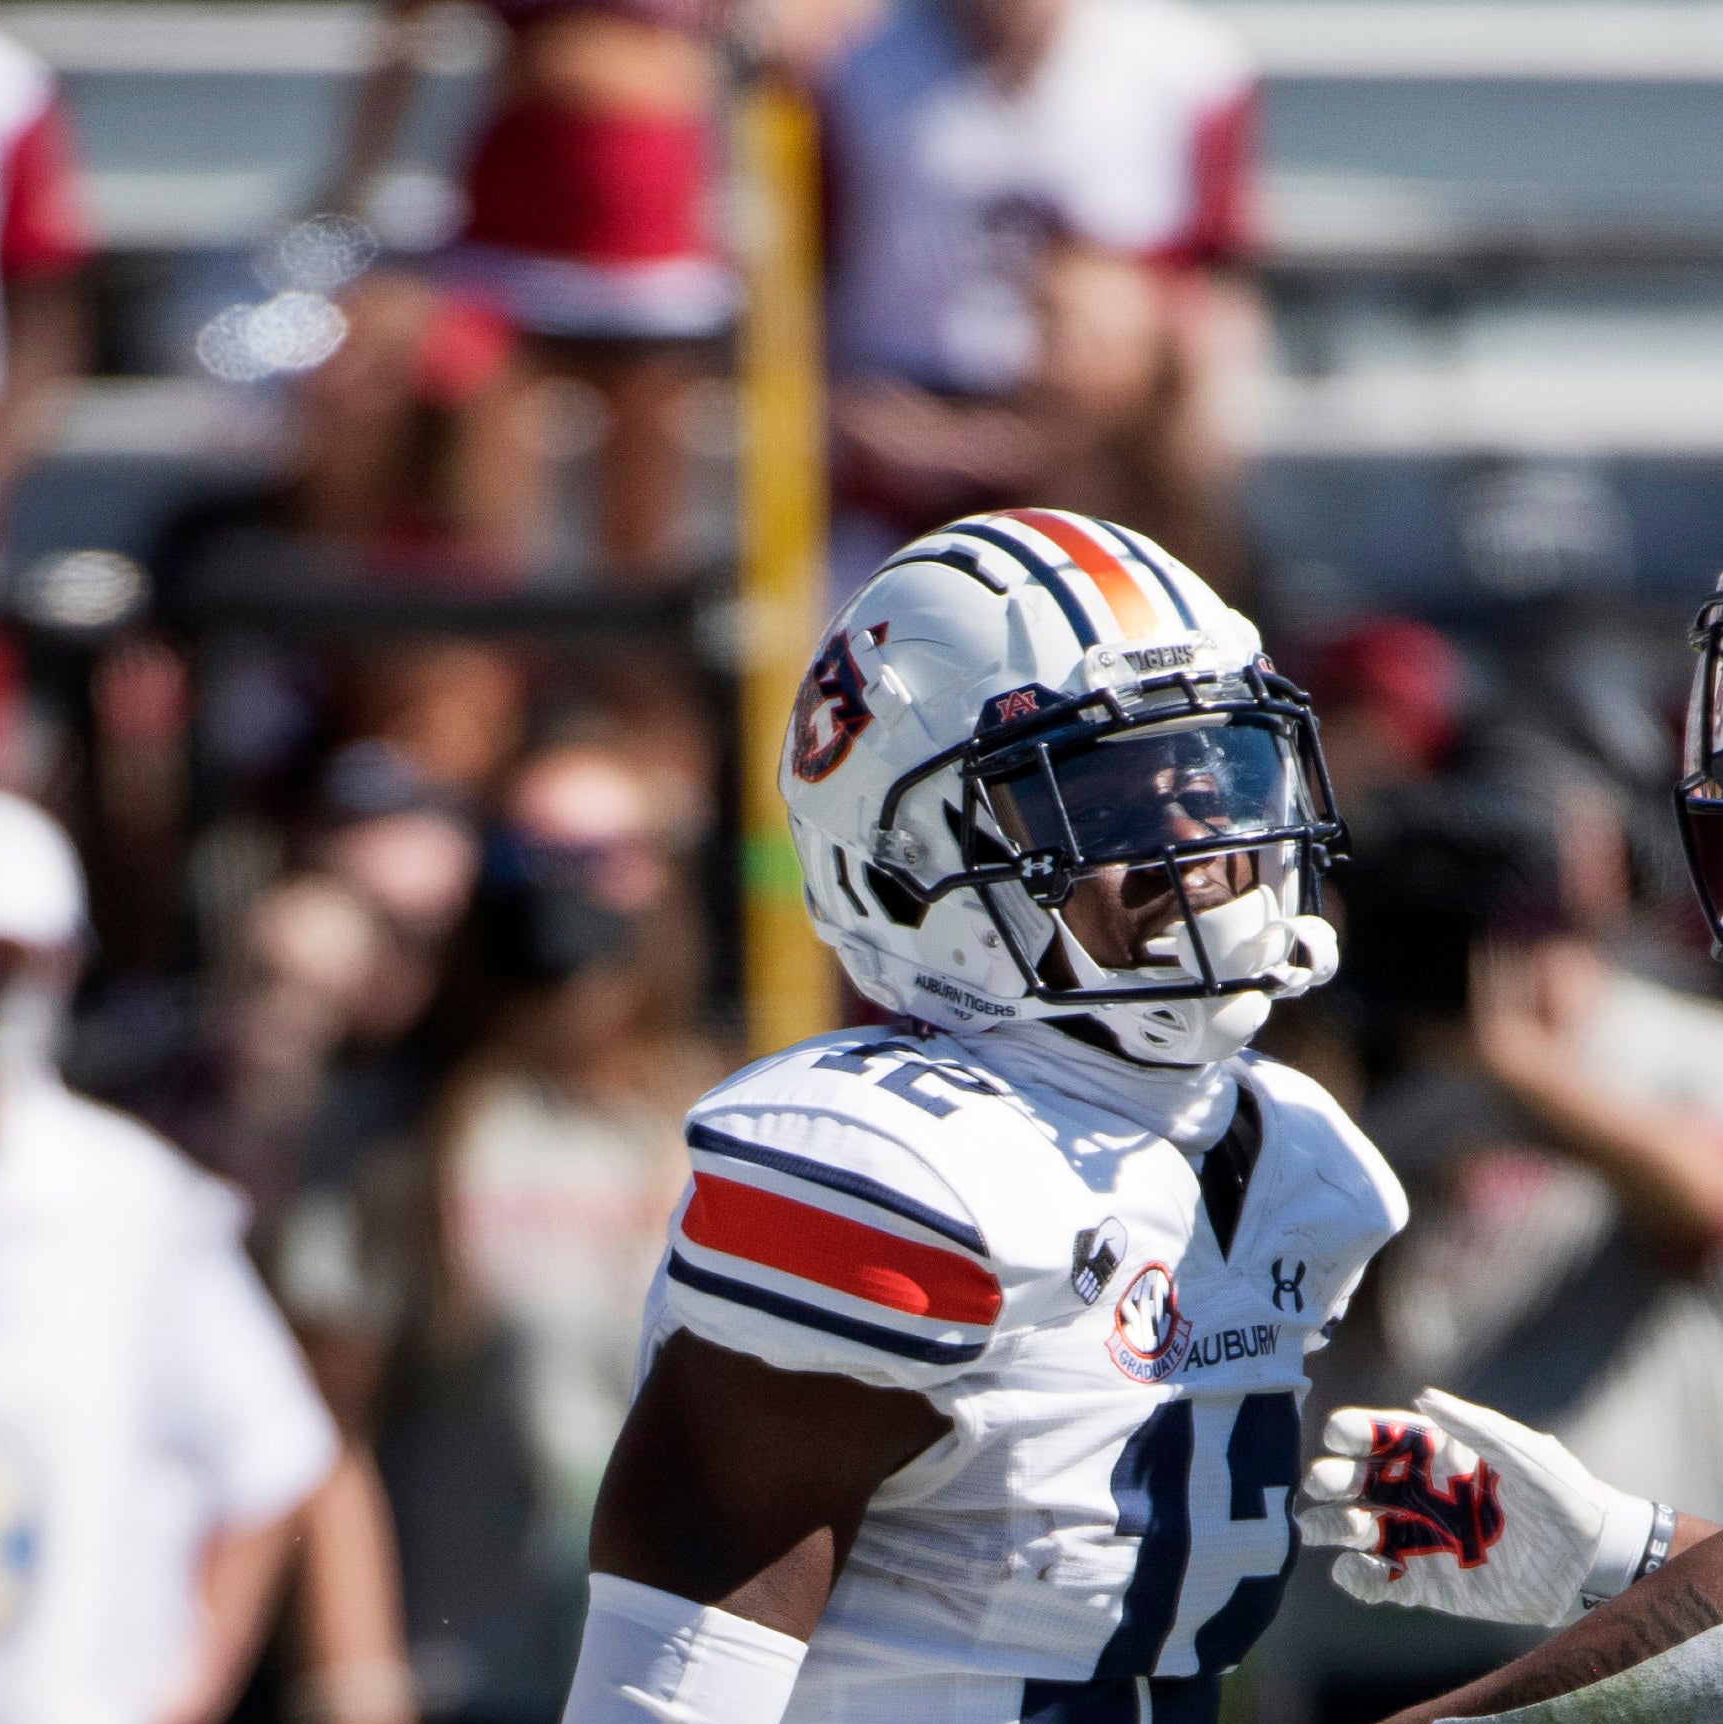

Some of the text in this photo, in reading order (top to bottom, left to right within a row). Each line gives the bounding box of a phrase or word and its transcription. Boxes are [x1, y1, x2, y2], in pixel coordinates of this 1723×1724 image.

[1121, 645, 1195, 672] TIGERS
[915, 974, 963, 1005] AUBURN
[963, 992, 1016, 1017] TIGERS
[1119, 1341, 1183, 1378] GRADUATE
[1183, 1324, 1280, 1372] AUBURN
